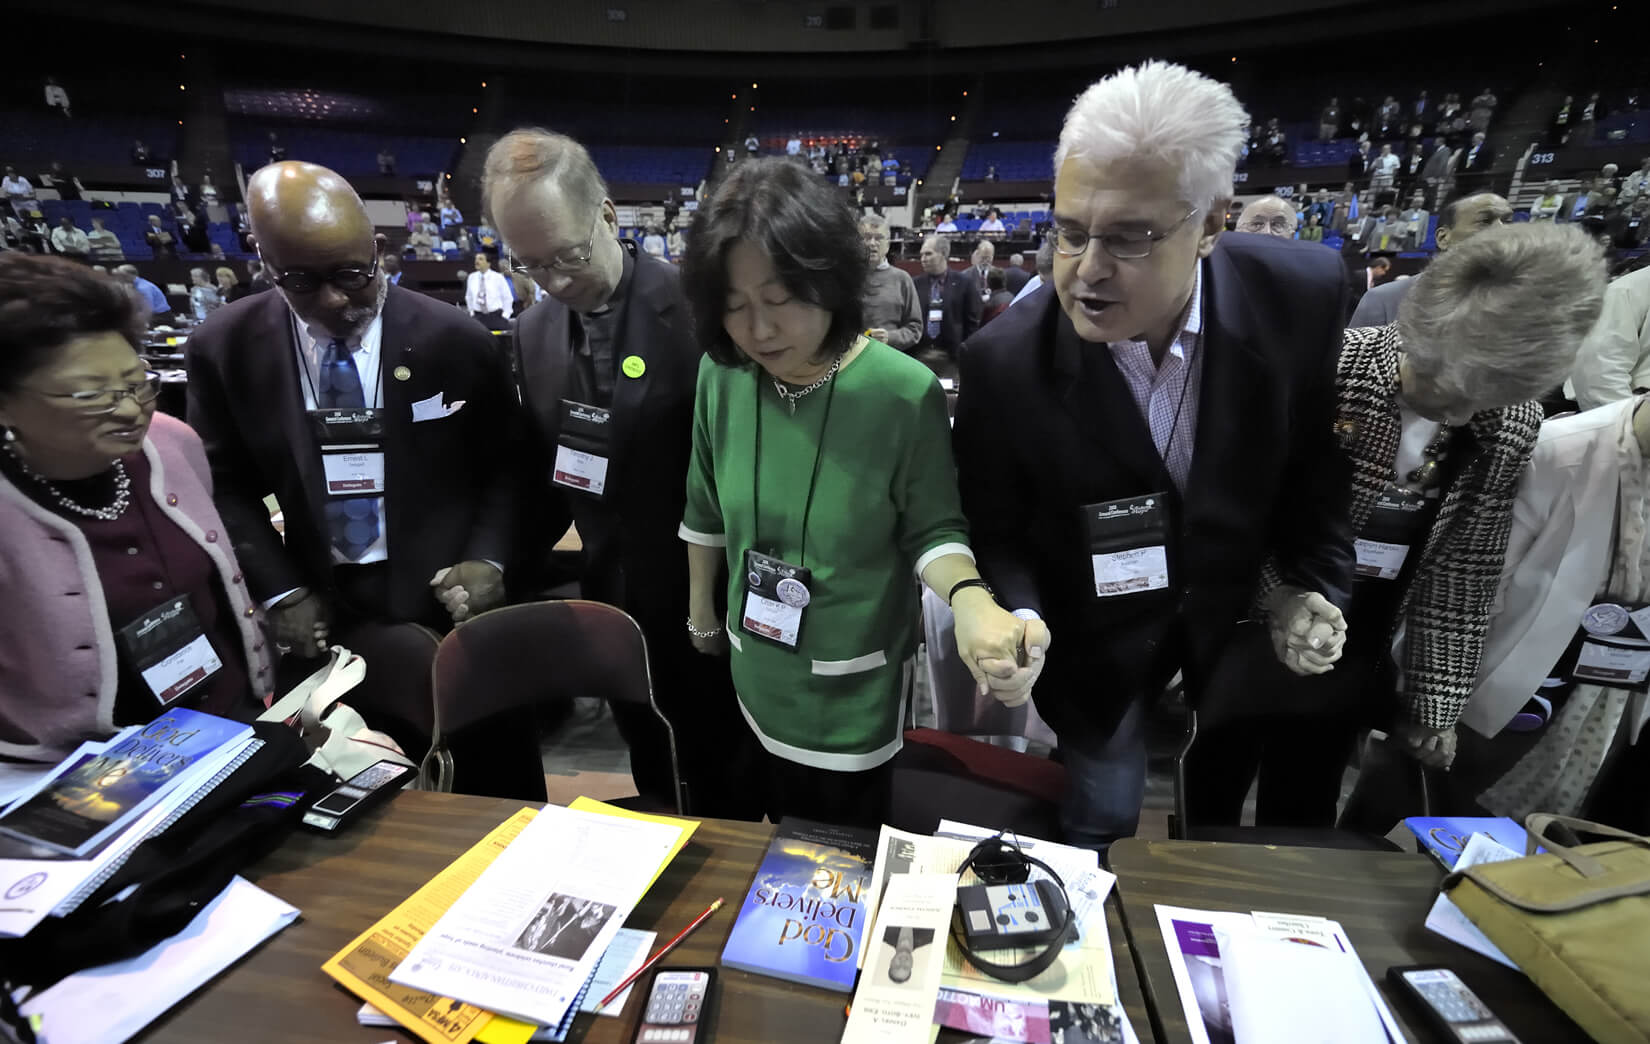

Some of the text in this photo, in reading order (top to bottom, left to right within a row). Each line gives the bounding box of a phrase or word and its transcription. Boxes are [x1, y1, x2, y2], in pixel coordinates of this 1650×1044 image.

[146, 168, 166, 178] 307
[1531, 153, 1555, 165] 313
[140, 717, 201, 748] God
[113, 737, 193, 771] Delivers
[92, 755, 127, 788] Me
[812, 867, 864, 905] Me
[753, 887, 857, 928] Delivers
[778, 918, 854, 963] God
